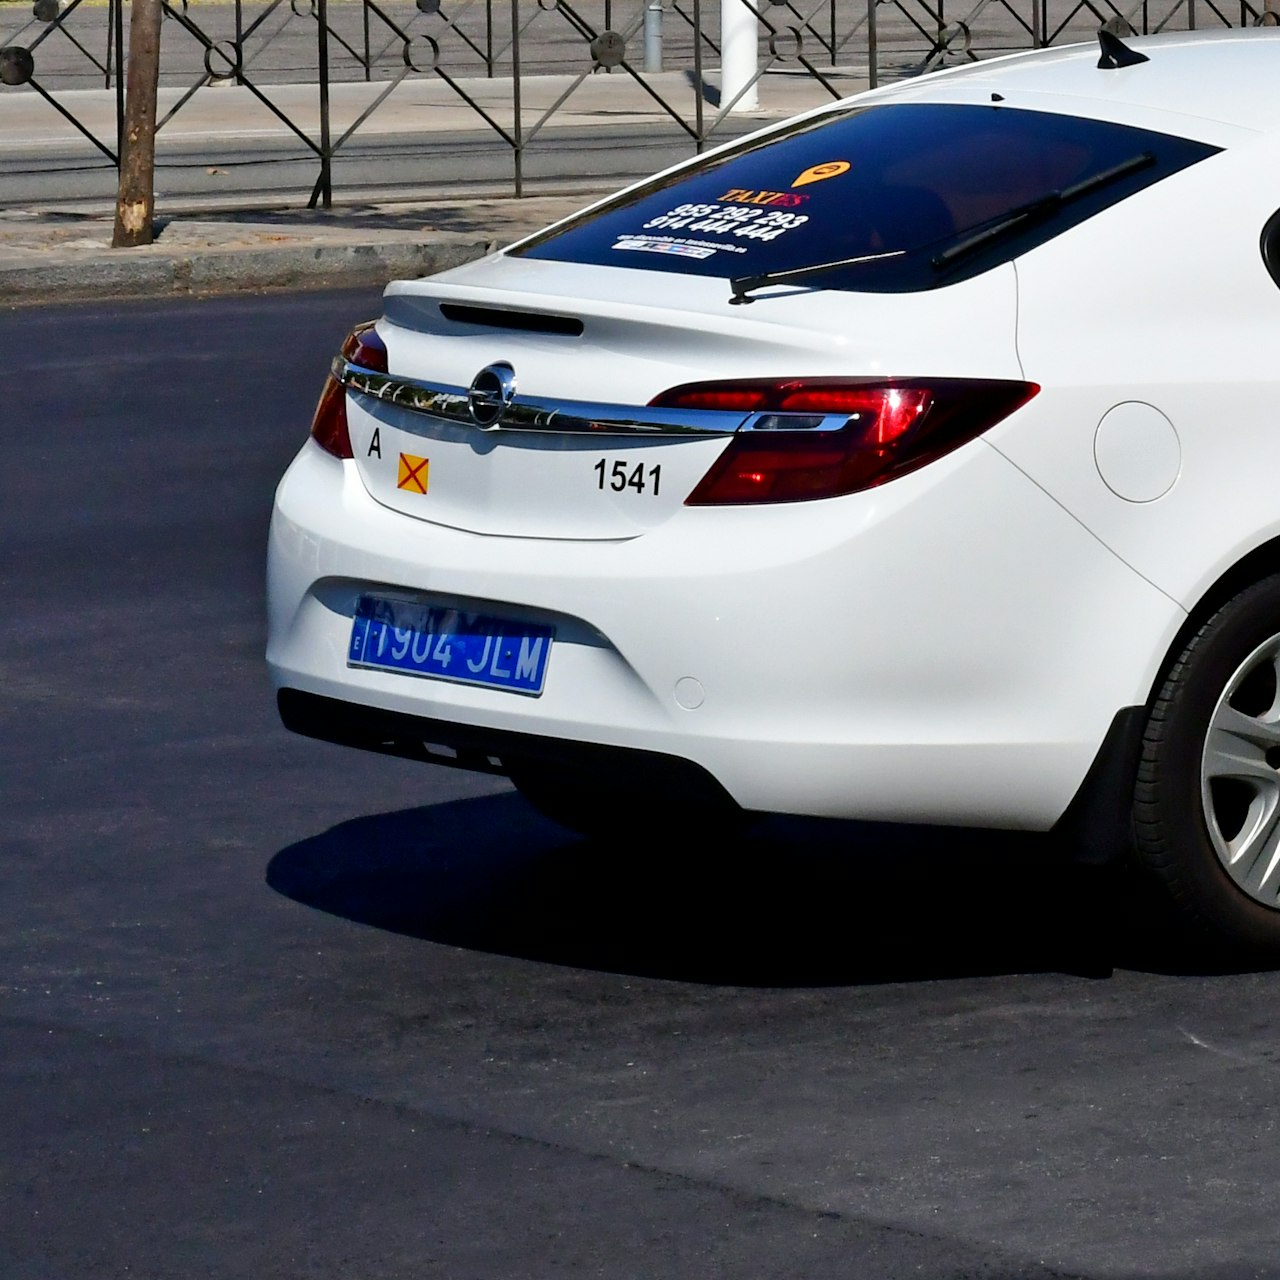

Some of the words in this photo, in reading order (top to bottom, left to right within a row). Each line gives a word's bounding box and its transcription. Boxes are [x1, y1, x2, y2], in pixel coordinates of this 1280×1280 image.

[716, 188, 803, 207] TAXIES
[643, 216, 695, 230] 914
[687, 218, 741, 235] 444
[731, 224, 787, 242] 444
[667, 203, 720, 218] 955
[709, 206, 764, 222] 292
[753, 211, 809, 229] 293
[367, 427, 382, 459] A
[594, 458, 661, 496] 1541
[353, 636, 361, 650] E
[376, 621, 451, 668] 1904
[466, 635, 544, 683] JLM
